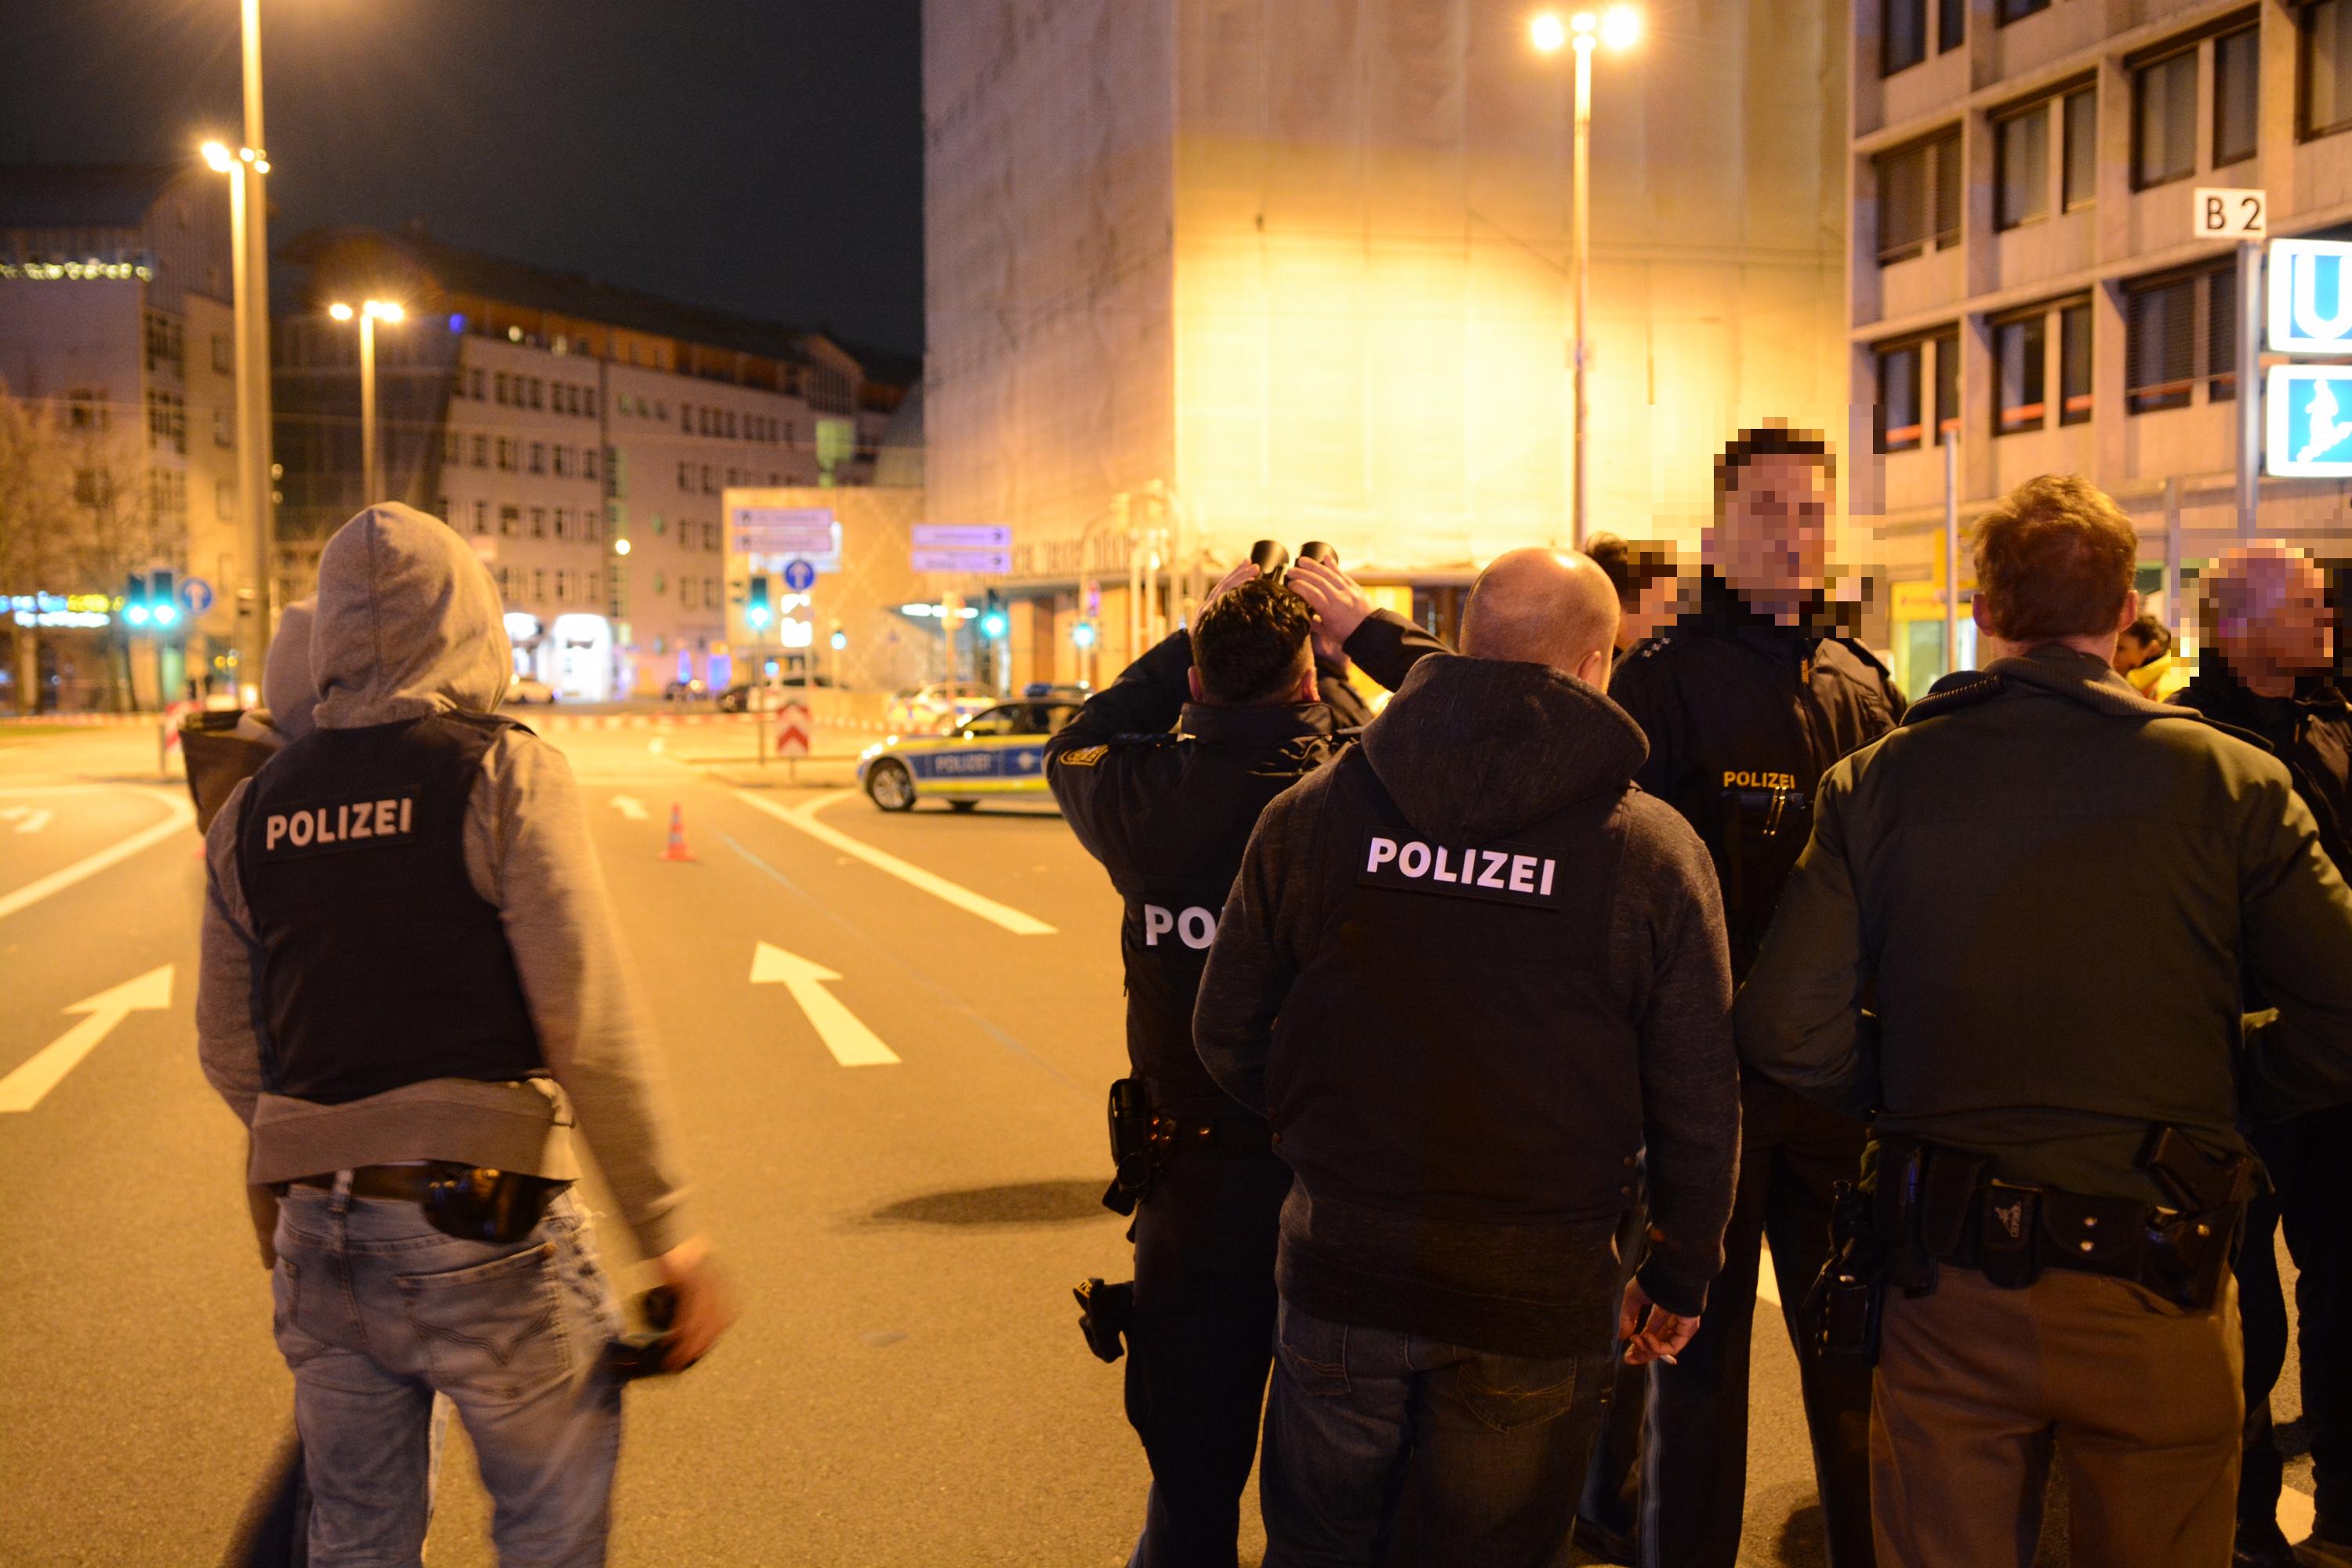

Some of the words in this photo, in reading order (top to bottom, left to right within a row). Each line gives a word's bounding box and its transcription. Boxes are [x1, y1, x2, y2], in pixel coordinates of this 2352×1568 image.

[2206, 198, 2226, 230] B
[2241, 198, 2262, 230] 2
[2293, 253, 2352, 339] U
[1723, 771, 1795, 789] POLIZEI
[266, 797, 412, 851] POLIZEI
[1367, 837, 1556, 896] POLIZEI
[1145, 903, 1226, 949] PO
